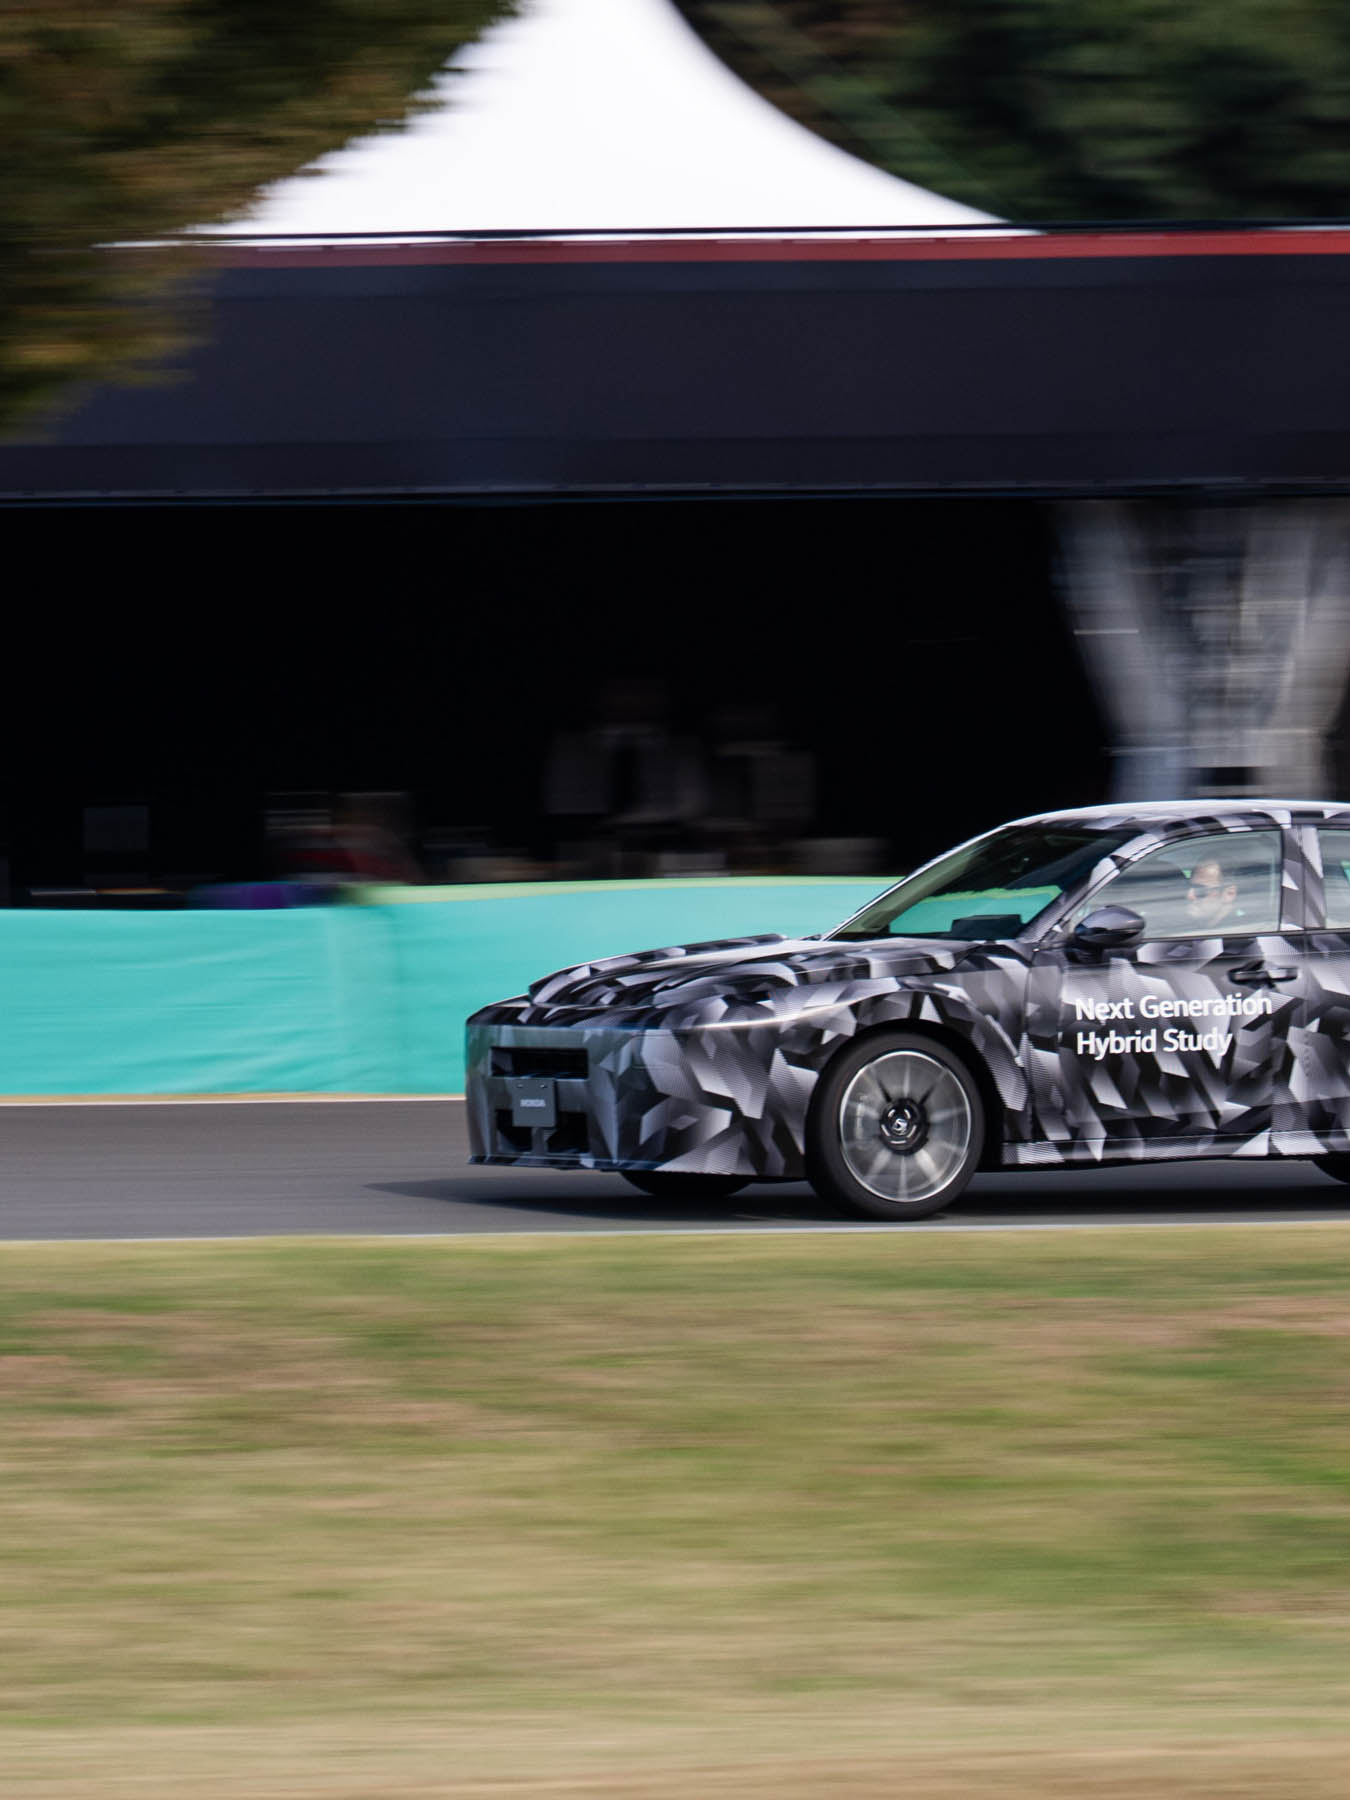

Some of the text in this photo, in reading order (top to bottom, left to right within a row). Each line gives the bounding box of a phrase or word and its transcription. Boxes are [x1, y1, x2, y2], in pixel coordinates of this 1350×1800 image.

[1076, 993, 1272, 1021] Next Generation
[1077, 1027, 1233, 1061] Hybrid Study
